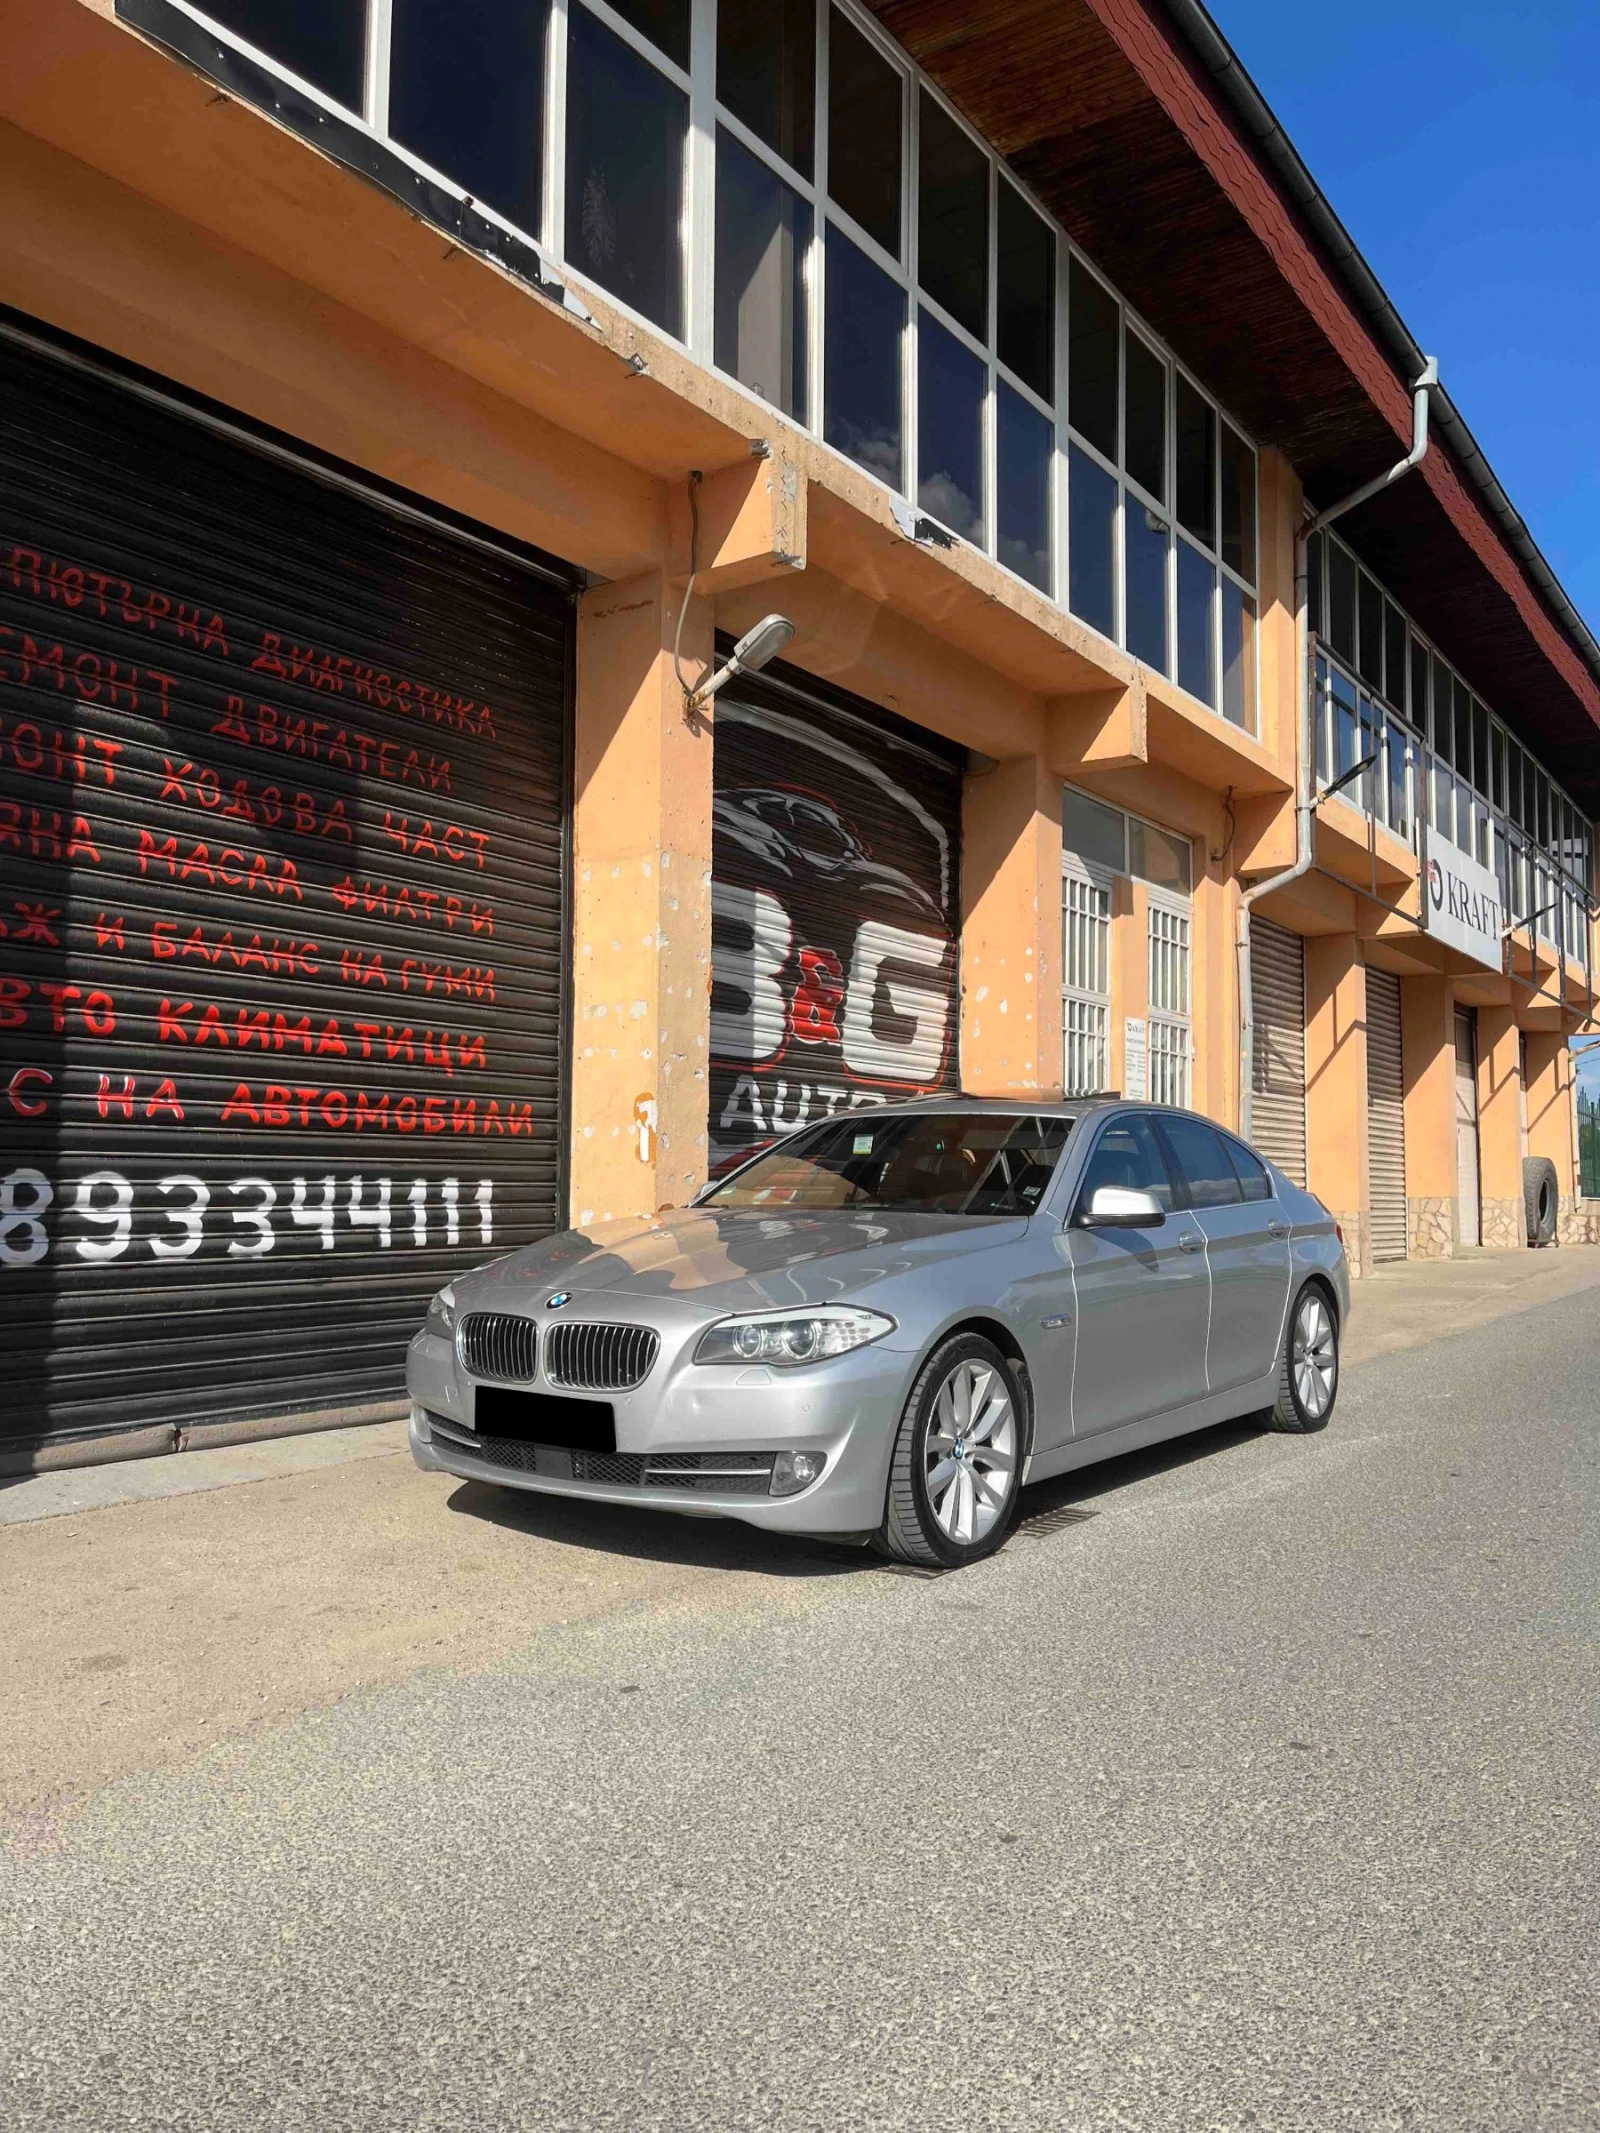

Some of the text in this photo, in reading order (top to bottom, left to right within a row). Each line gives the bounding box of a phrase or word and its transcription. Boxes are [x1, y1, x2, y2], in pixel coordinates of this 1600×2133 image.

[250, 632, 496, 738] ДИАГНОСТИКА
[210, 695, 451, 790] ДВИГАТЕЛИ
[0, 717, 490, 869] ОНТ ХОДОВА ЧАСТ
[137, 830, 303, 900] МАСЛА
[331, 876, 494, 937] ФИЛТРИ
[1447, 870, 1498, 941] KRAFT
[95, 913, 125, 950] И
[151, 922, 319, 975] БАЛАНС
[341, 949, 388, 987] НА
[400, 959, 496, 1001] ГУМИ
[157, 998, 487, 1077] КЛИМАТИЦИ
[97, 1074, 185, 1120] НА
[221, 1083, 533, 1136] АВТОМОБИЛИ
